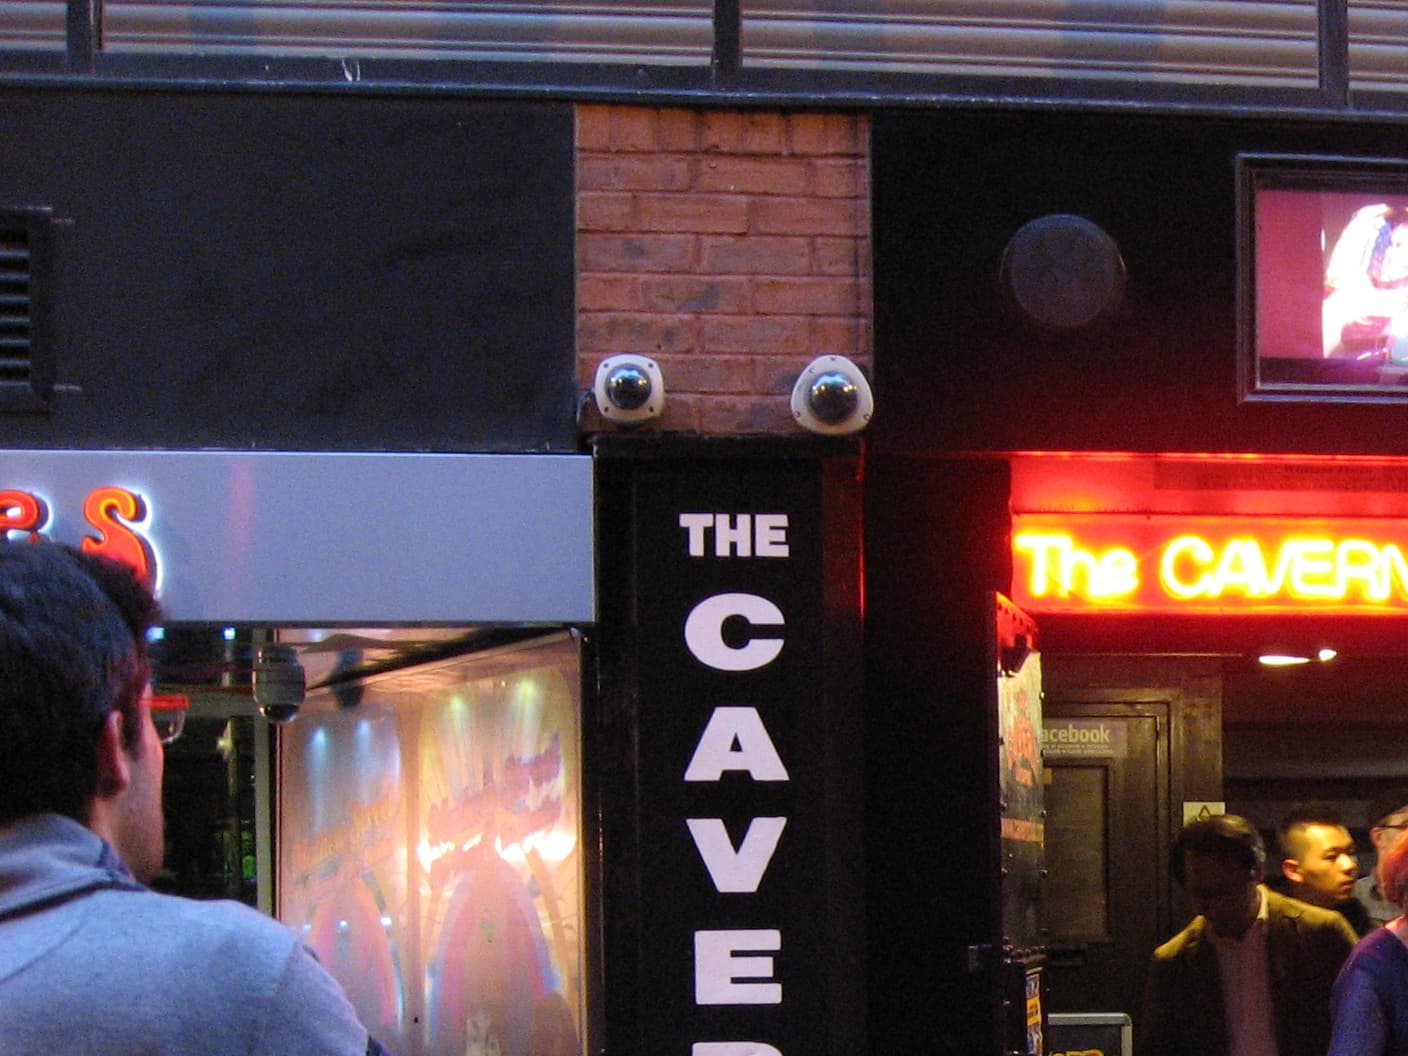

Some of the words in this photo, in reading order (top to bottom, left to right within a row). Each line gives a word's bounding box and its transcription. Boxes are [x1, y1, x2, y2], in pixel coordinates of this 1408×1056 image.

[679, 513, 790, 557] THE
[1013, 534, 1141, 598] The
[1041, 723, 1111, 743] acebook
